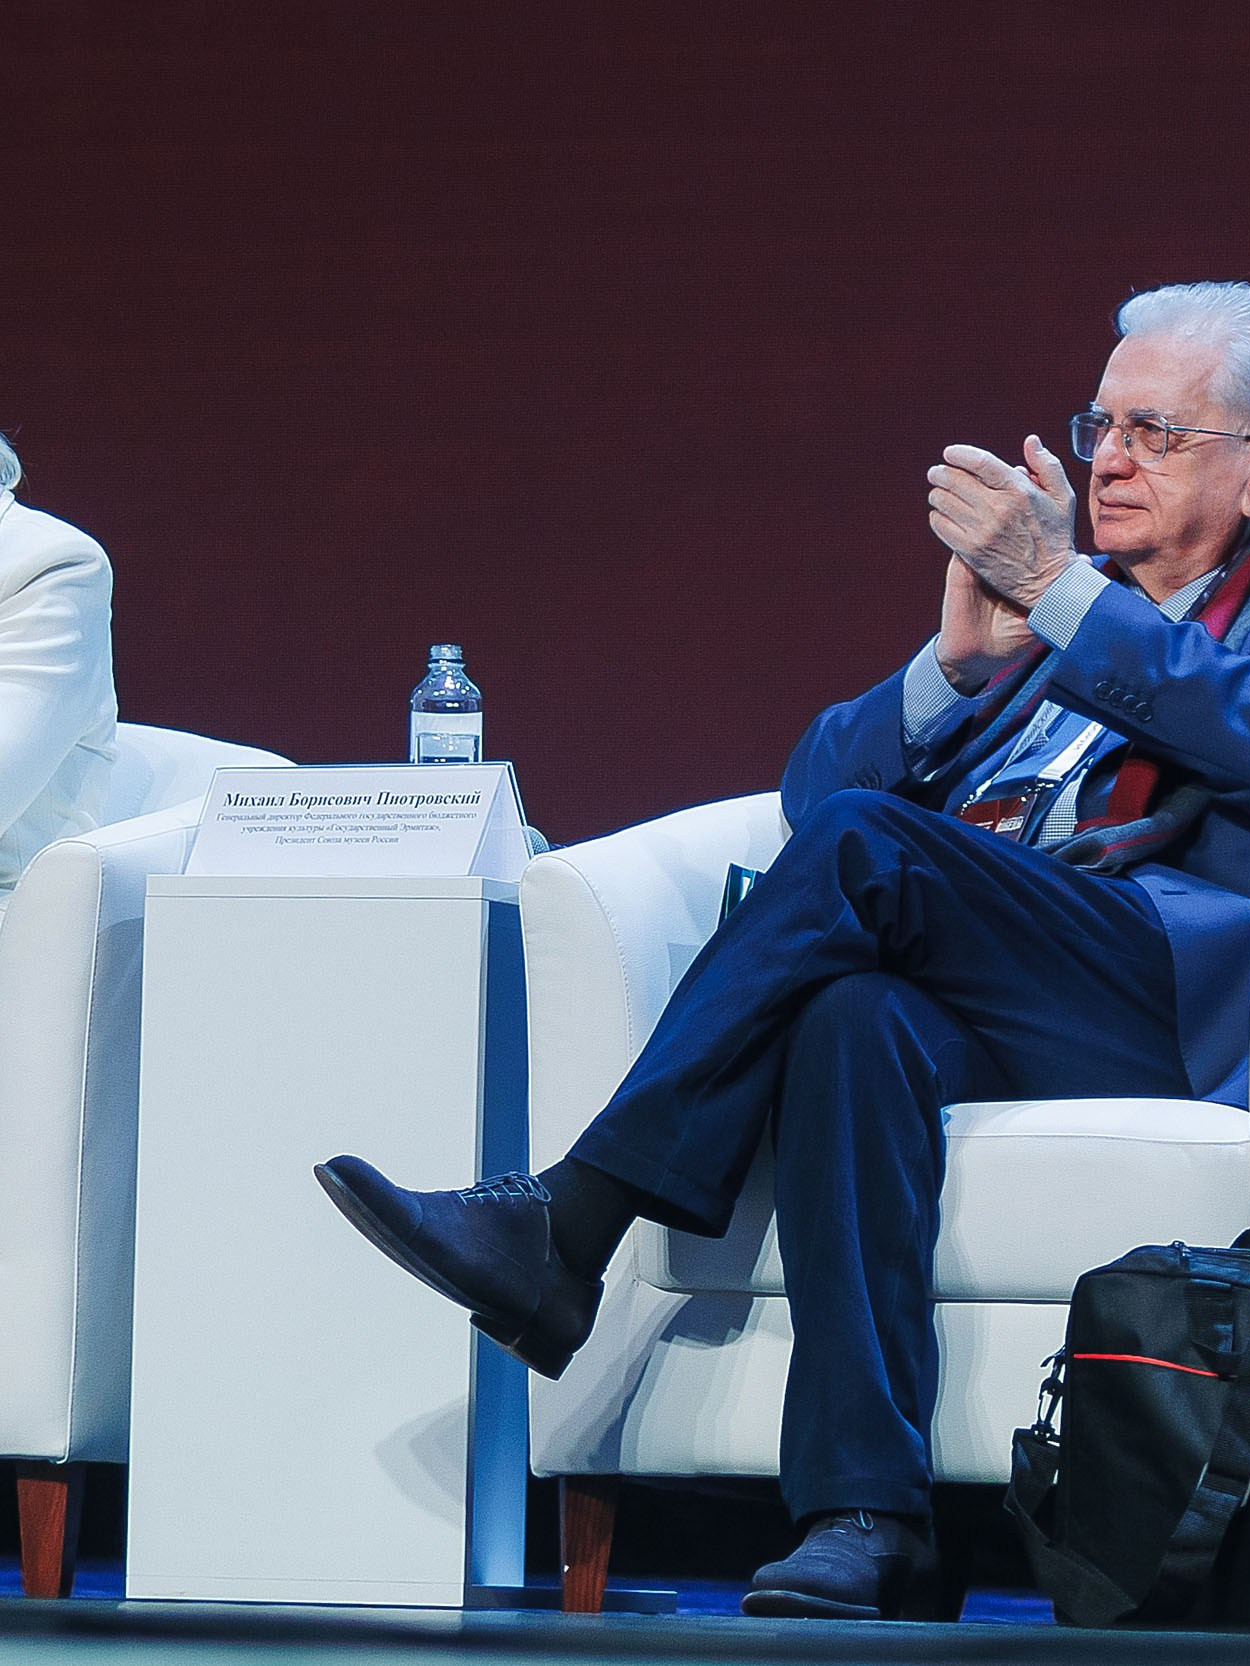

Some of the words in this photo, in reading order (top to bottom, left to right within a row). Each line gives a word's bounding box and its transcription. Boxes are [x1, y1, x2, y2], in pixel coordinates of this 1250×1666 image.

[223, 793, 285, 807] Михаил
[289, 792, 372, 809] Борисович
[376, 790, 481, 808] Пиотровский
